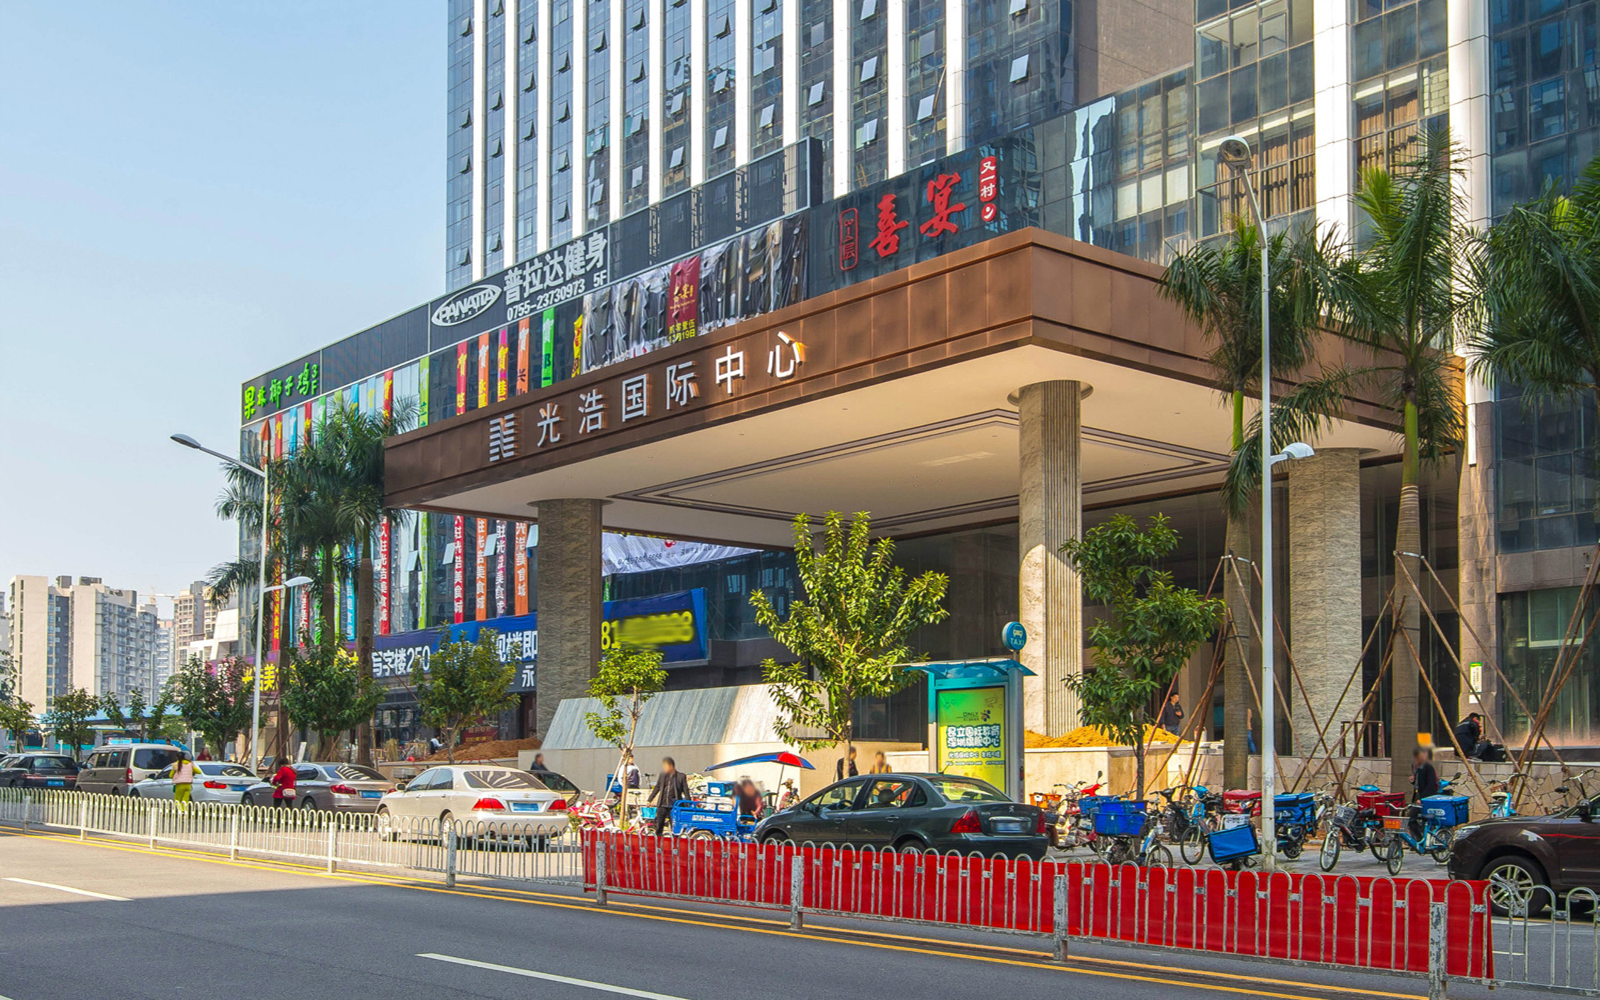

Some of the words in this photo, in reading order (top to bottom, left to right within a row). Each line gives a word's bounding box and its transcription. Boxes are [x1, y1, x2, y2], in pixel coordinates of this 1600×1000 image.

[980, 160, 996, 198] 又一村
[868, 171, 967, 258] 喜宴
[503, 231, 607, 306] 普拉达健身
[506, 278, 586, 321] 0755-23730973
[593, 269, 607, 288] 5F
[536, 330, 801, 448] 光浩国际中心
[1010, 637, 1025, 646] TAXI
